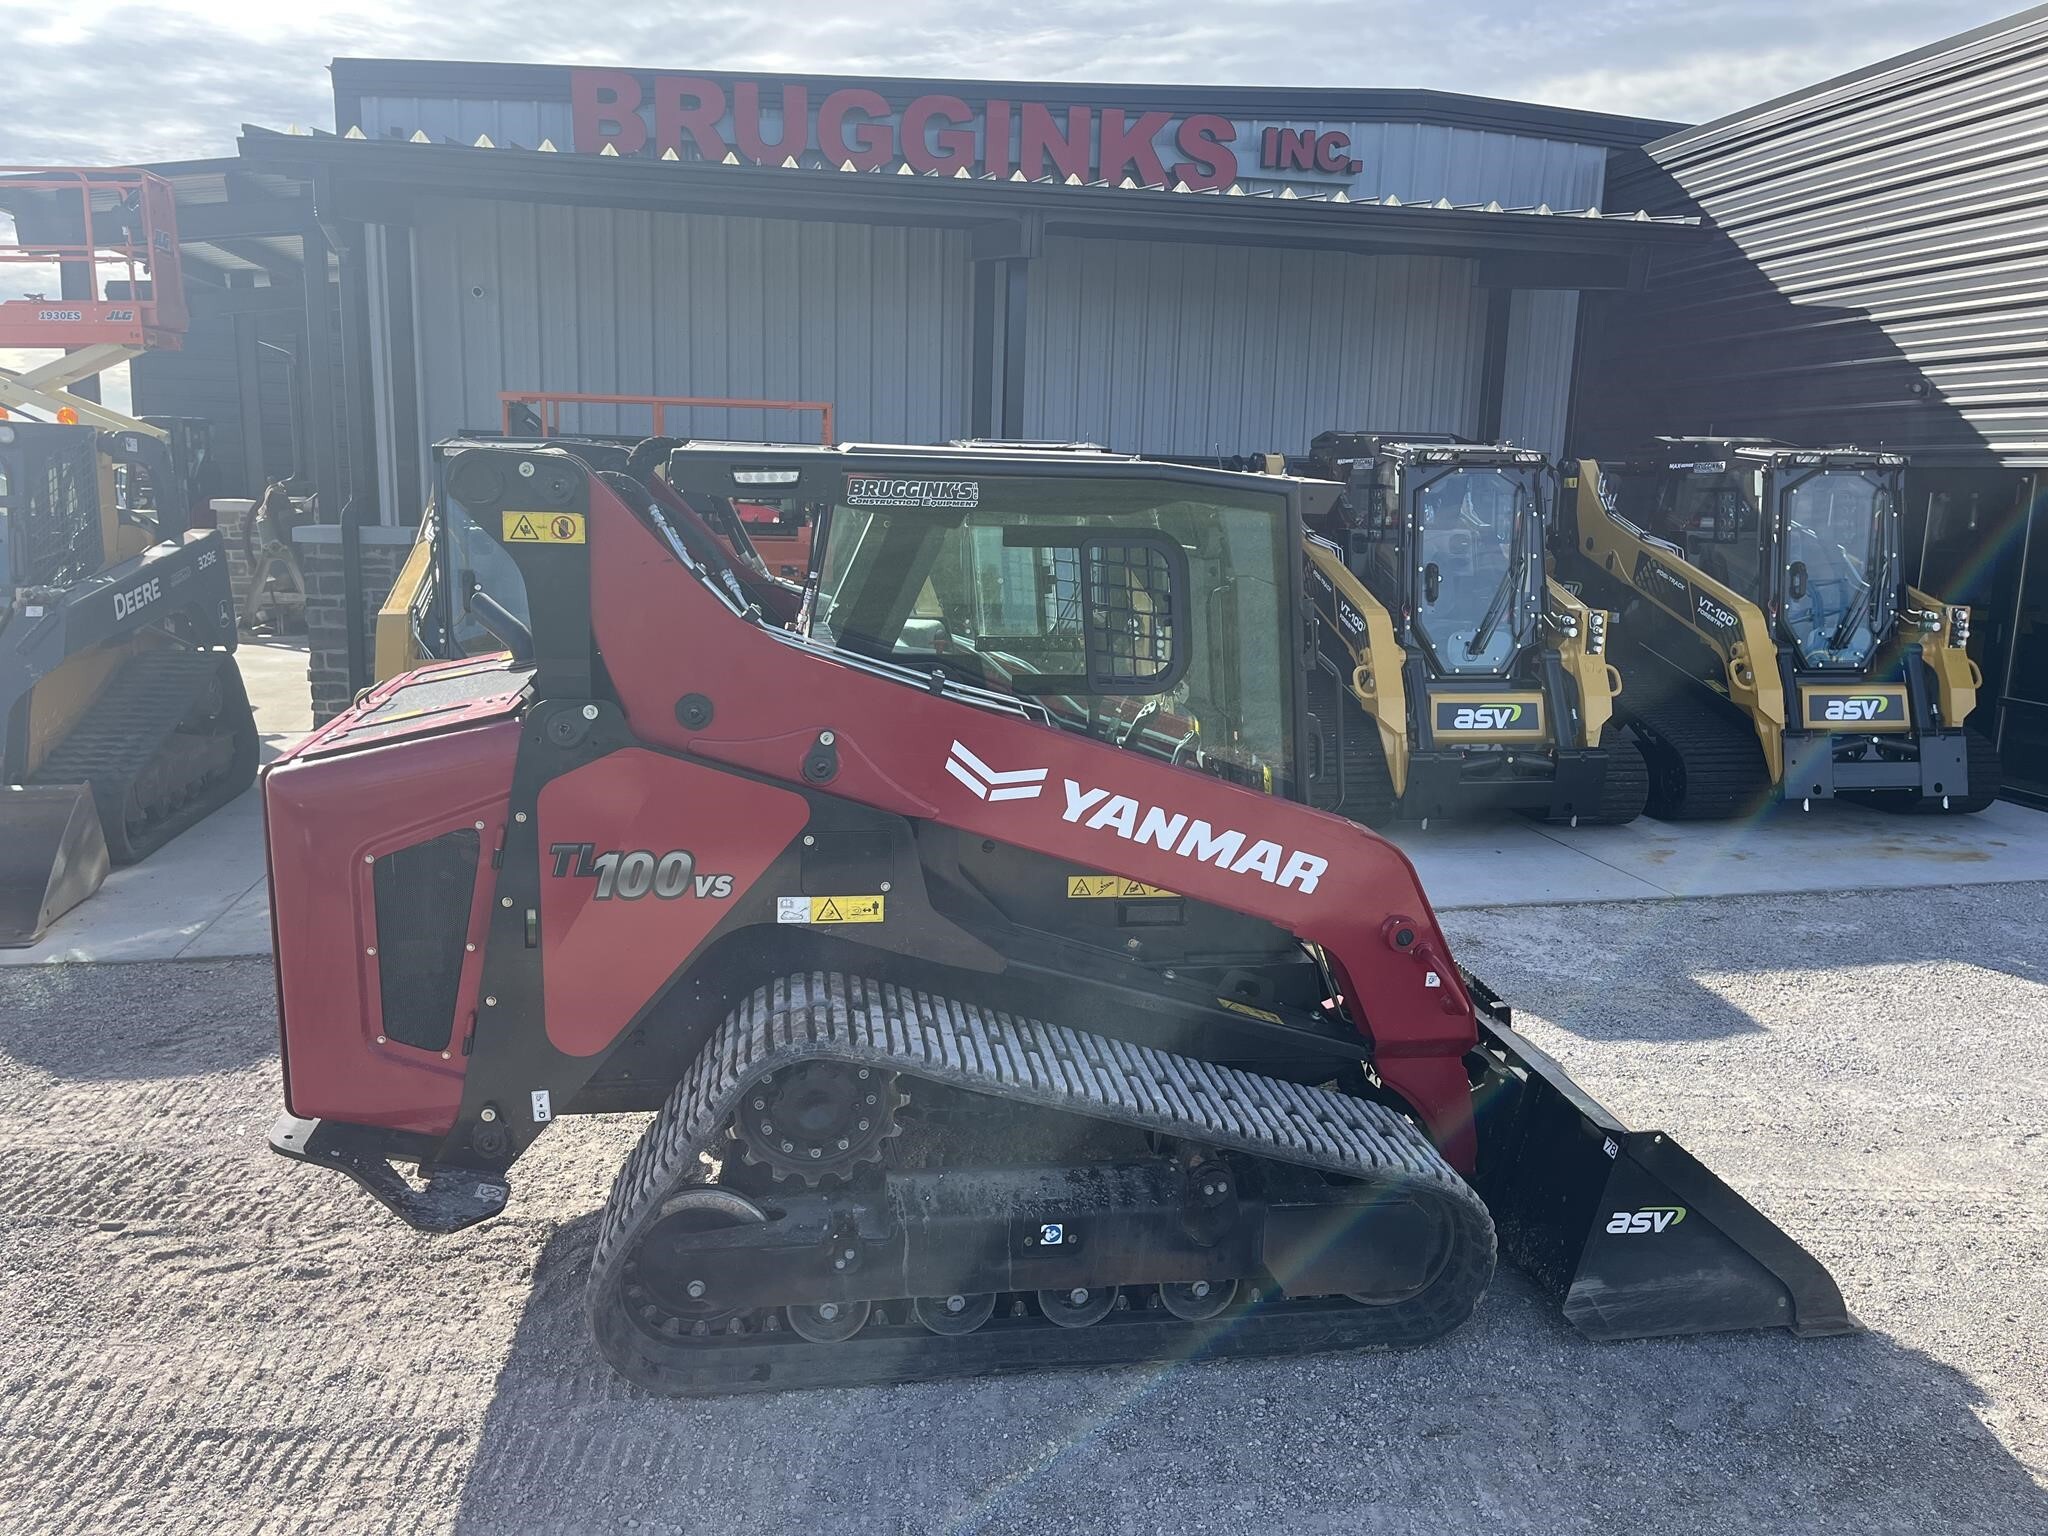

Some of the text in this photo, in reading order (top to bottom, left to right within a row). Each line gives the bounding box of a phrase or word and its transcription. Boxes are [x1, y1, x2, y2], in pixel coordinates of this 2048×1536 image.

[570, 69, 1364, 192] BRUGGINKS INC.
[39, 310, 133, 321] 1930ES JLG
[848, 479, 973, 499] BRUGGINK'S
[847, 497, 978, 507] CONSTRUCTION EQUIPMENT
[198, 550, 217, 570] 329E
[113, 577, 162, 620] DEERE
[1340, 600, 1364, 632] VT-100
[1697, 607, 1725, 629] FORESTRY
[1699, 596, 1734, 627] VT-100
[1062, 778, 1329, 895] YANMAR
[1605, 1139, 1617, 1157] 78
